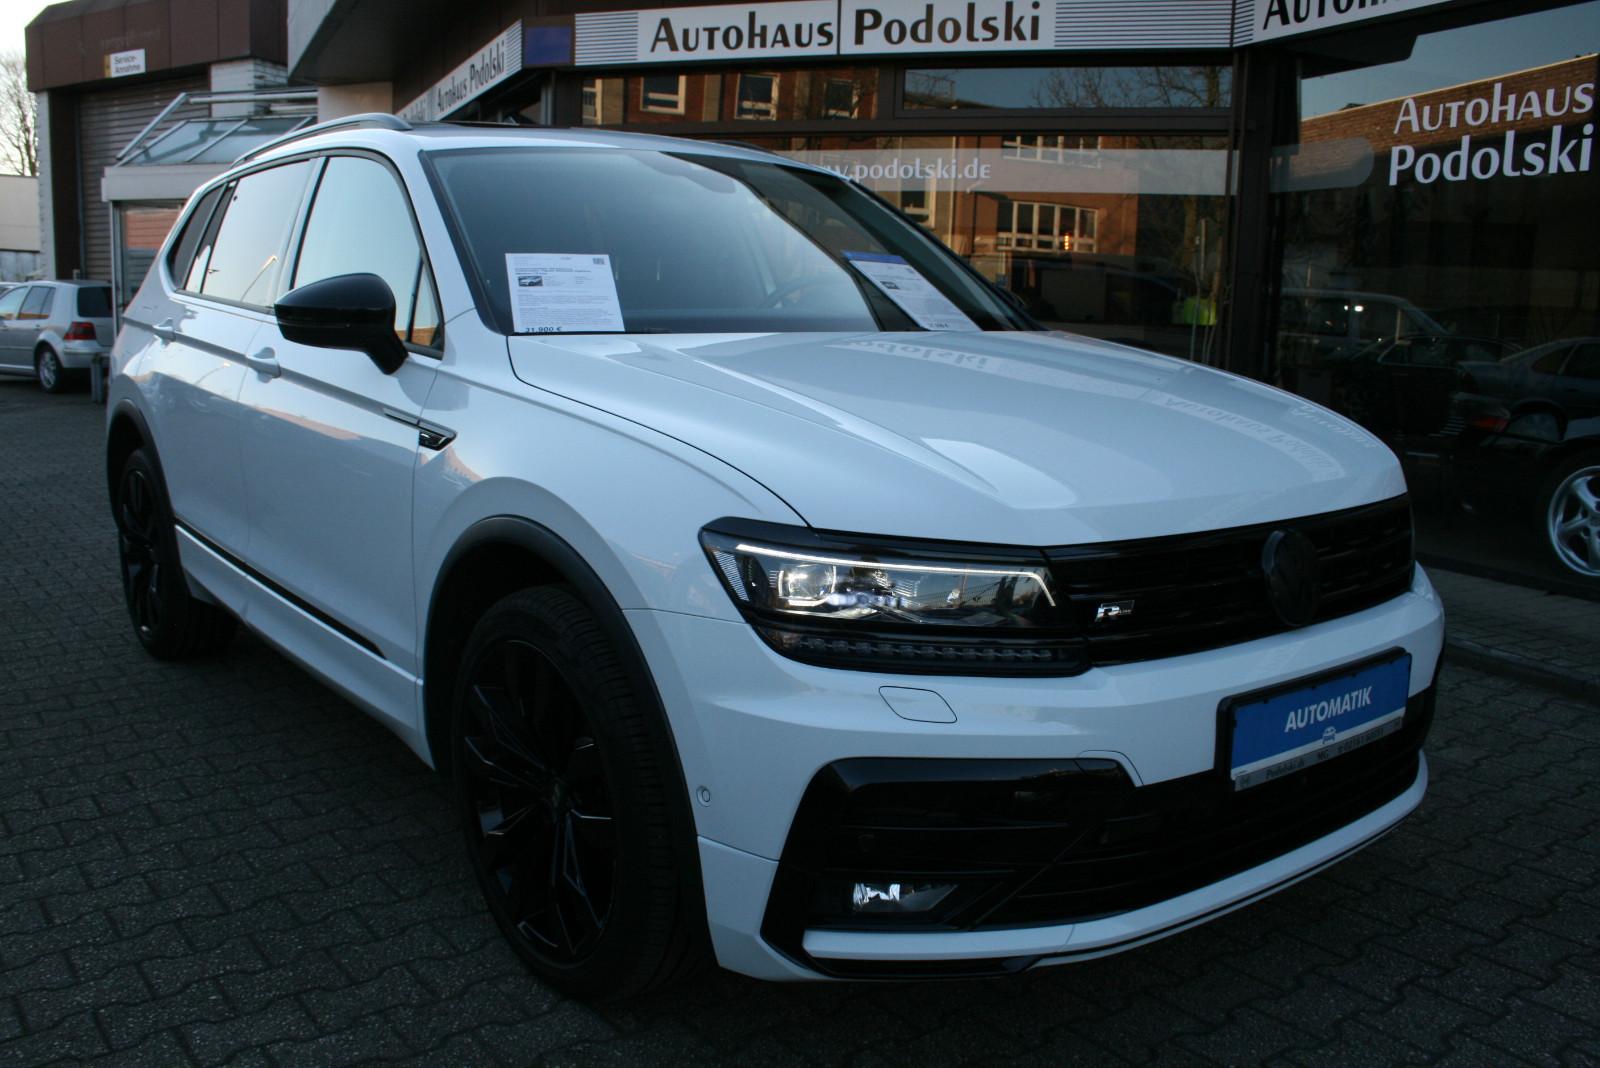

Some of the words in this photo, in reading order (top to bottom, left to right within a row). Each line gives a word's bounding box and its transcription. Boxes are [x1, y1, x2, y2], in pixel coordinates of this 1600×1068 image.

[854, 1, 1041, 46] Podolski
[469, 40, 505, 94] Podolski
[1388, 123, 1595, 187] Podolski
[1284, 686, 1373, 733] AUTOMATIK
